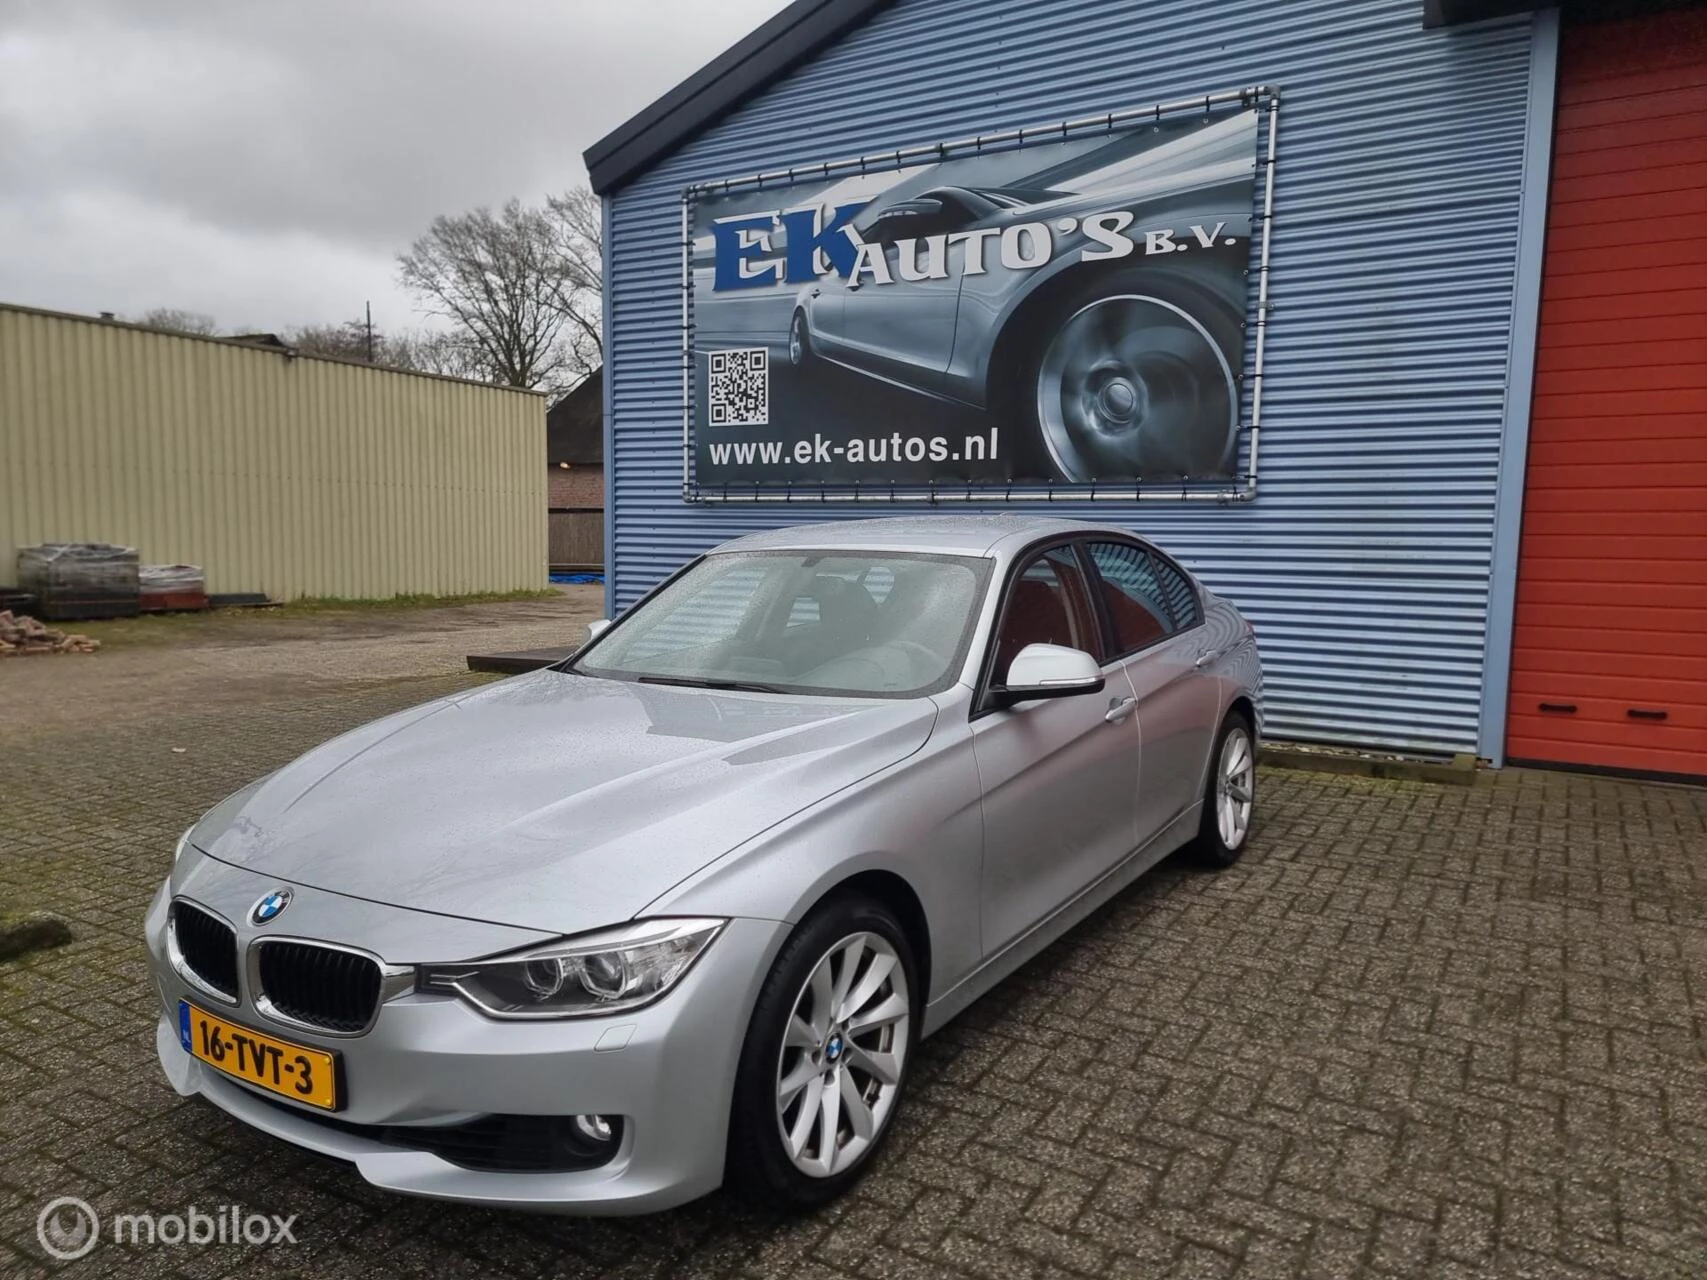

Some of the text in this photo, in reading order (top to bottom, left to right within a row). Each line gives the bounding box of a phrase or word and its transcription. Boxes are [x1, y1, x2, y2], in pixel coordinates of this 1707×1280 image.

[711, 201, 879, 292] EK
[846, 211, 1135, 288] AUTO'S
[709, 426, 999, 466] www.ek-autos.nl
[200, 1019, 313, 1095] 16-TVT-3
